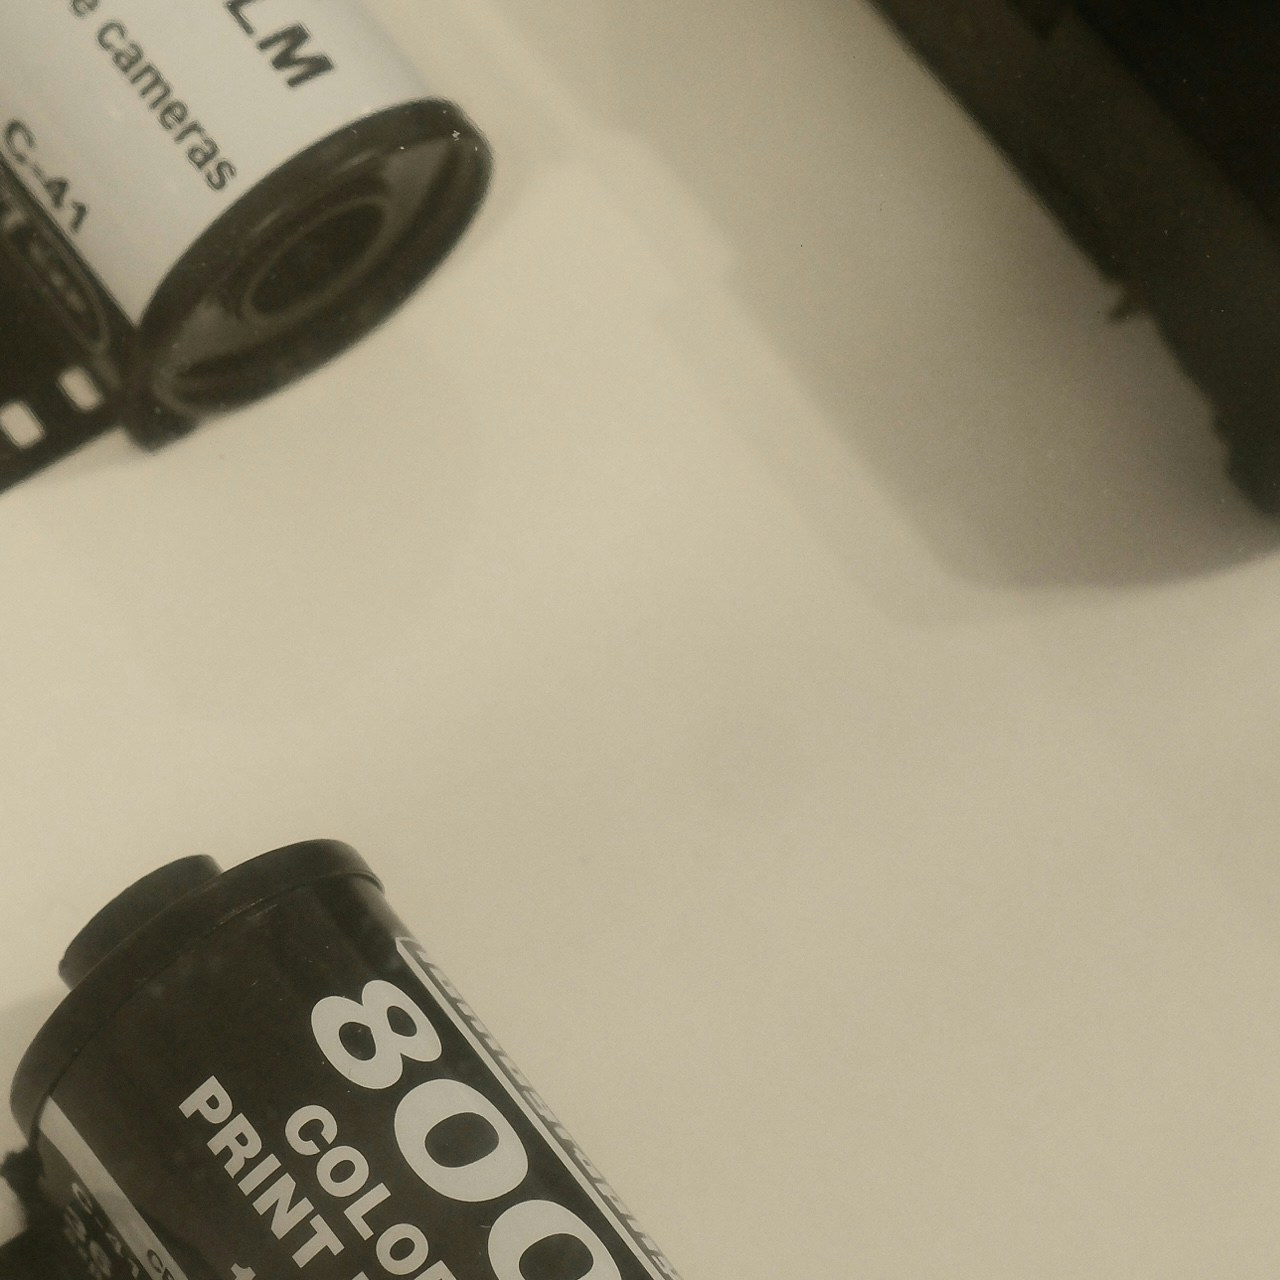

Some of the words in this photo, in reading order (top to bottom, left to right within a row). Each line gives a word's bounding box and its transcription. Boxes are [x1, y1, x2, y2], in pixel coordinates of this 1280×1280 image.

[3, 119, 89, 234] C-41
[96, 19, 239, 194] cameras
[178, 1074, 344, 1269] PRINT
